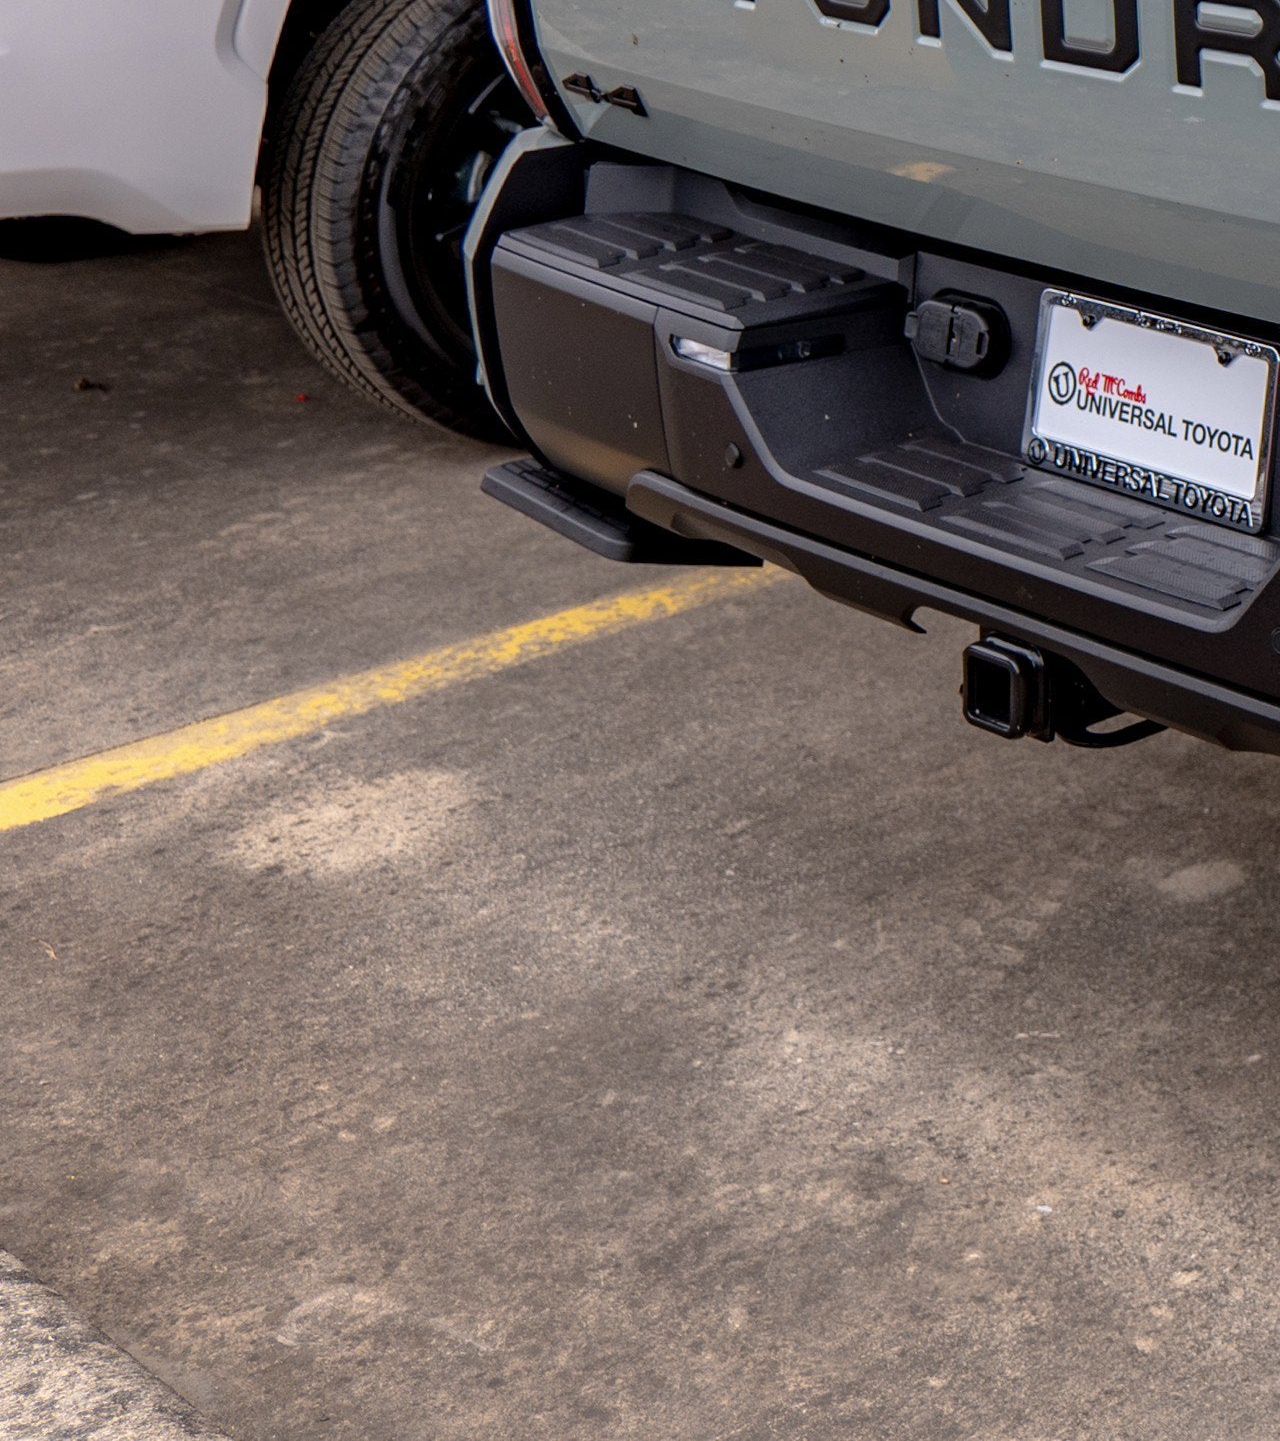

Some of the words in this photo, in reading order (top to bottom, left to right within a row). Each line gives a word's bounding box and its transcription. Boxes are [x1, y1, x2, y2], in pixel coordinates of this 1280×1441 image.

[1078, 366, 1100, 396] Red
[1102, 372, 1147, 405] McCombs
[1076, 388, 1178, 437] UNIVERSAL
[1182, 418, 1254, 461] TOYOTA
[1054, 443, 1170, 501] UNIVERSAL
[1171, 478, 1254, 528] TOYOTA
